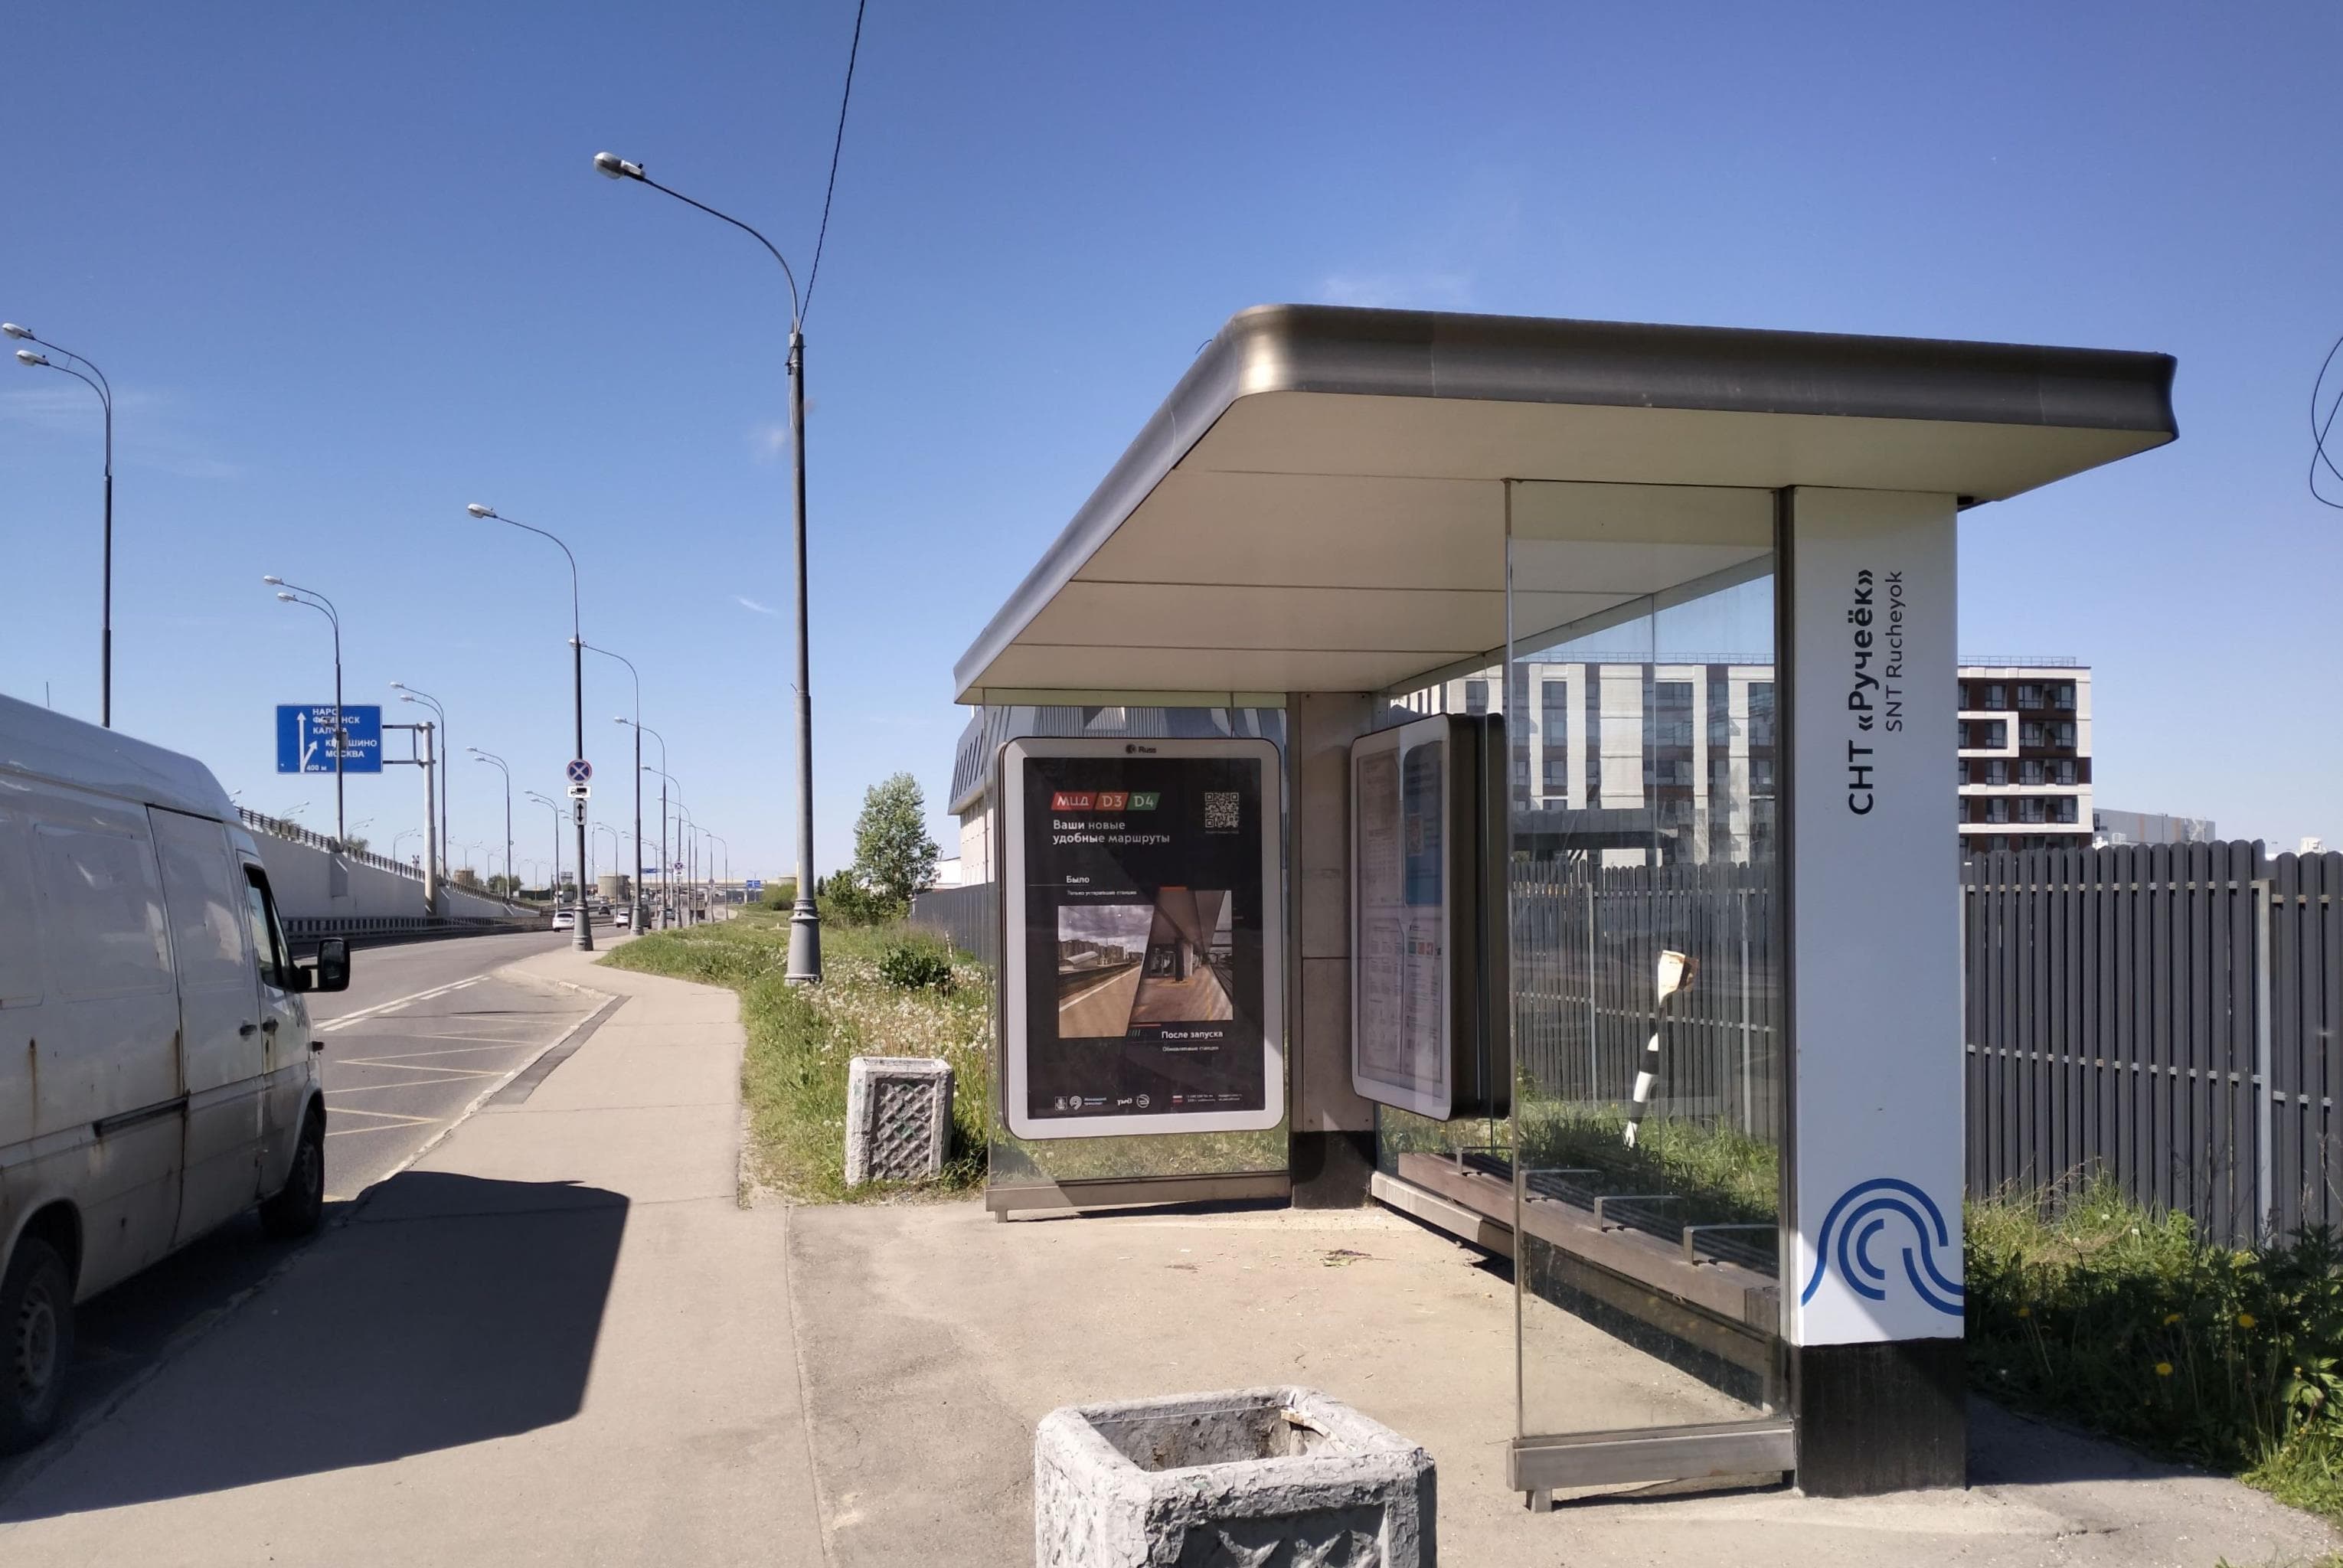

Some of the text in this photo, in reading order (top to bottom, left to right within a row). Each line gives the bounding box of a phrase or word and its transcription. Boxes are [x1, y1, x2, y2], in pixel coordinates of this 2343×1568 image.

[1885, 570, 1906, 732] SNT Rucheyok
[1848, 569, 1879, 815] СНТ «Ручеёк»
[312, 716, 361, 724] ФМНСК
[1102, 795, 1122, 807] D3
[1134, 795, 1155, 807] D4
[1053, 819, 1126, 830] Ваши новые
[1053, 832, 1171, 844] удобные маршруты
[1066, 875, 1090, 884] Было
[1162, 1031, 1224, 1039] После запуска
